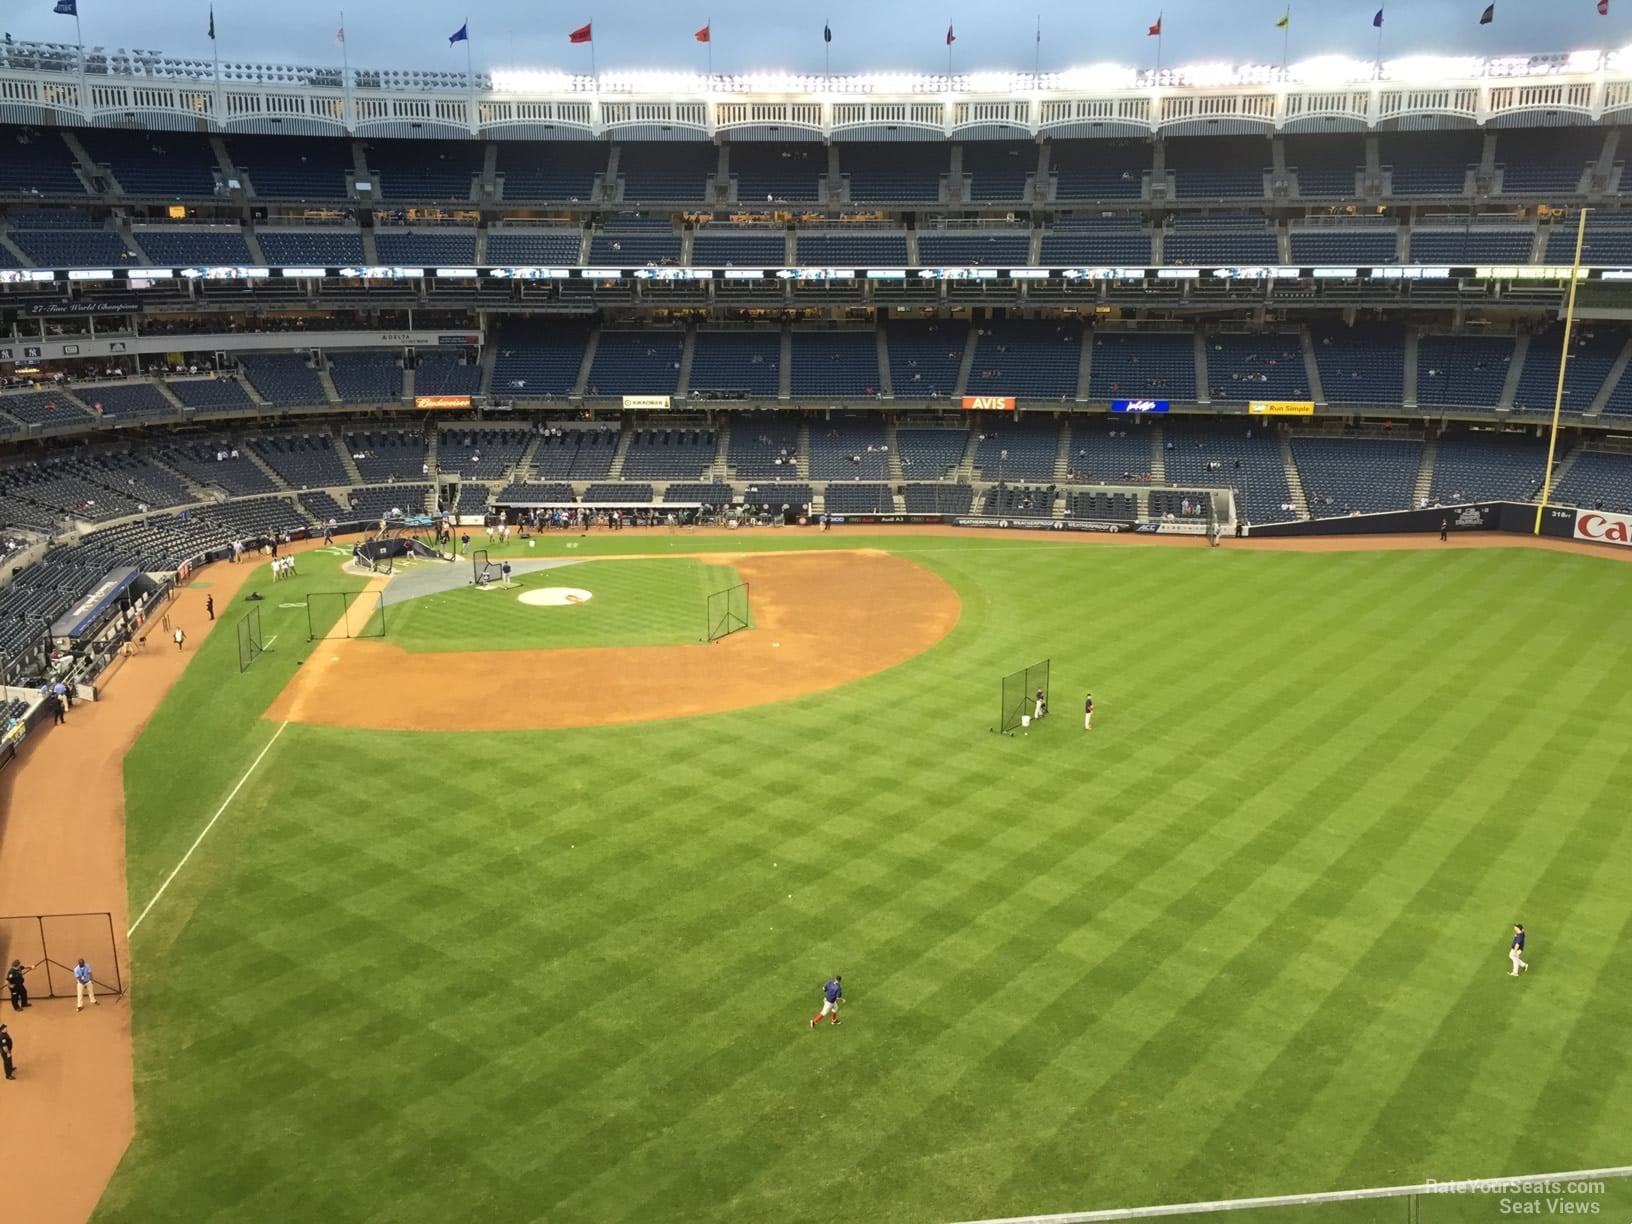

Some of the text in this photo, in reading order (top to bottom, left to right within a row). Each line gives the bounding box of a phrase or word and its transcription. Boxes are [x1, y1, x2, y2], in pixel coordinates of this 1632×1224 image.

[69, 303, 96, 312] World
[416, 398, 471, 408] Budweiser
[972, 398, 1005, 410] AVIS
[1284, 405, 1310, 413] Simple
[1578, 514, 1632, 543] Ca
